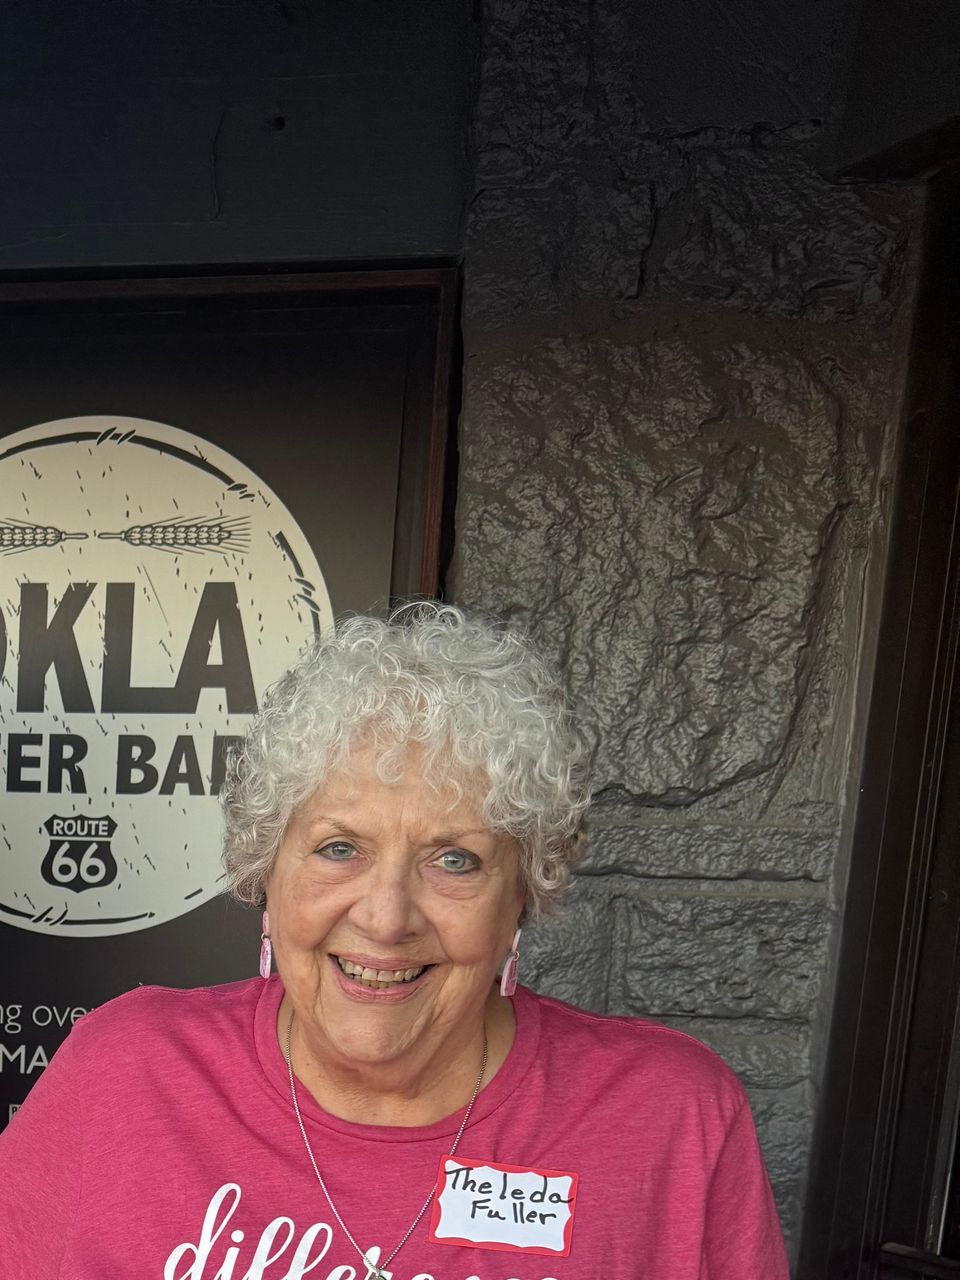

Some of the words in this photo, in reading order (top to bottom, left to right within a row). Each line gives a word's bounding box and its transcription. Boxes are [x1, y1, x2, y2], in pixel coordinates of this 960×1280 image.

[52, 819, 109, 836] ROUTE
[52, 841, 106, 884] 66
[32, 1005, 95, 1028] ove
[471, 1199, 557, 1224] Fuller
